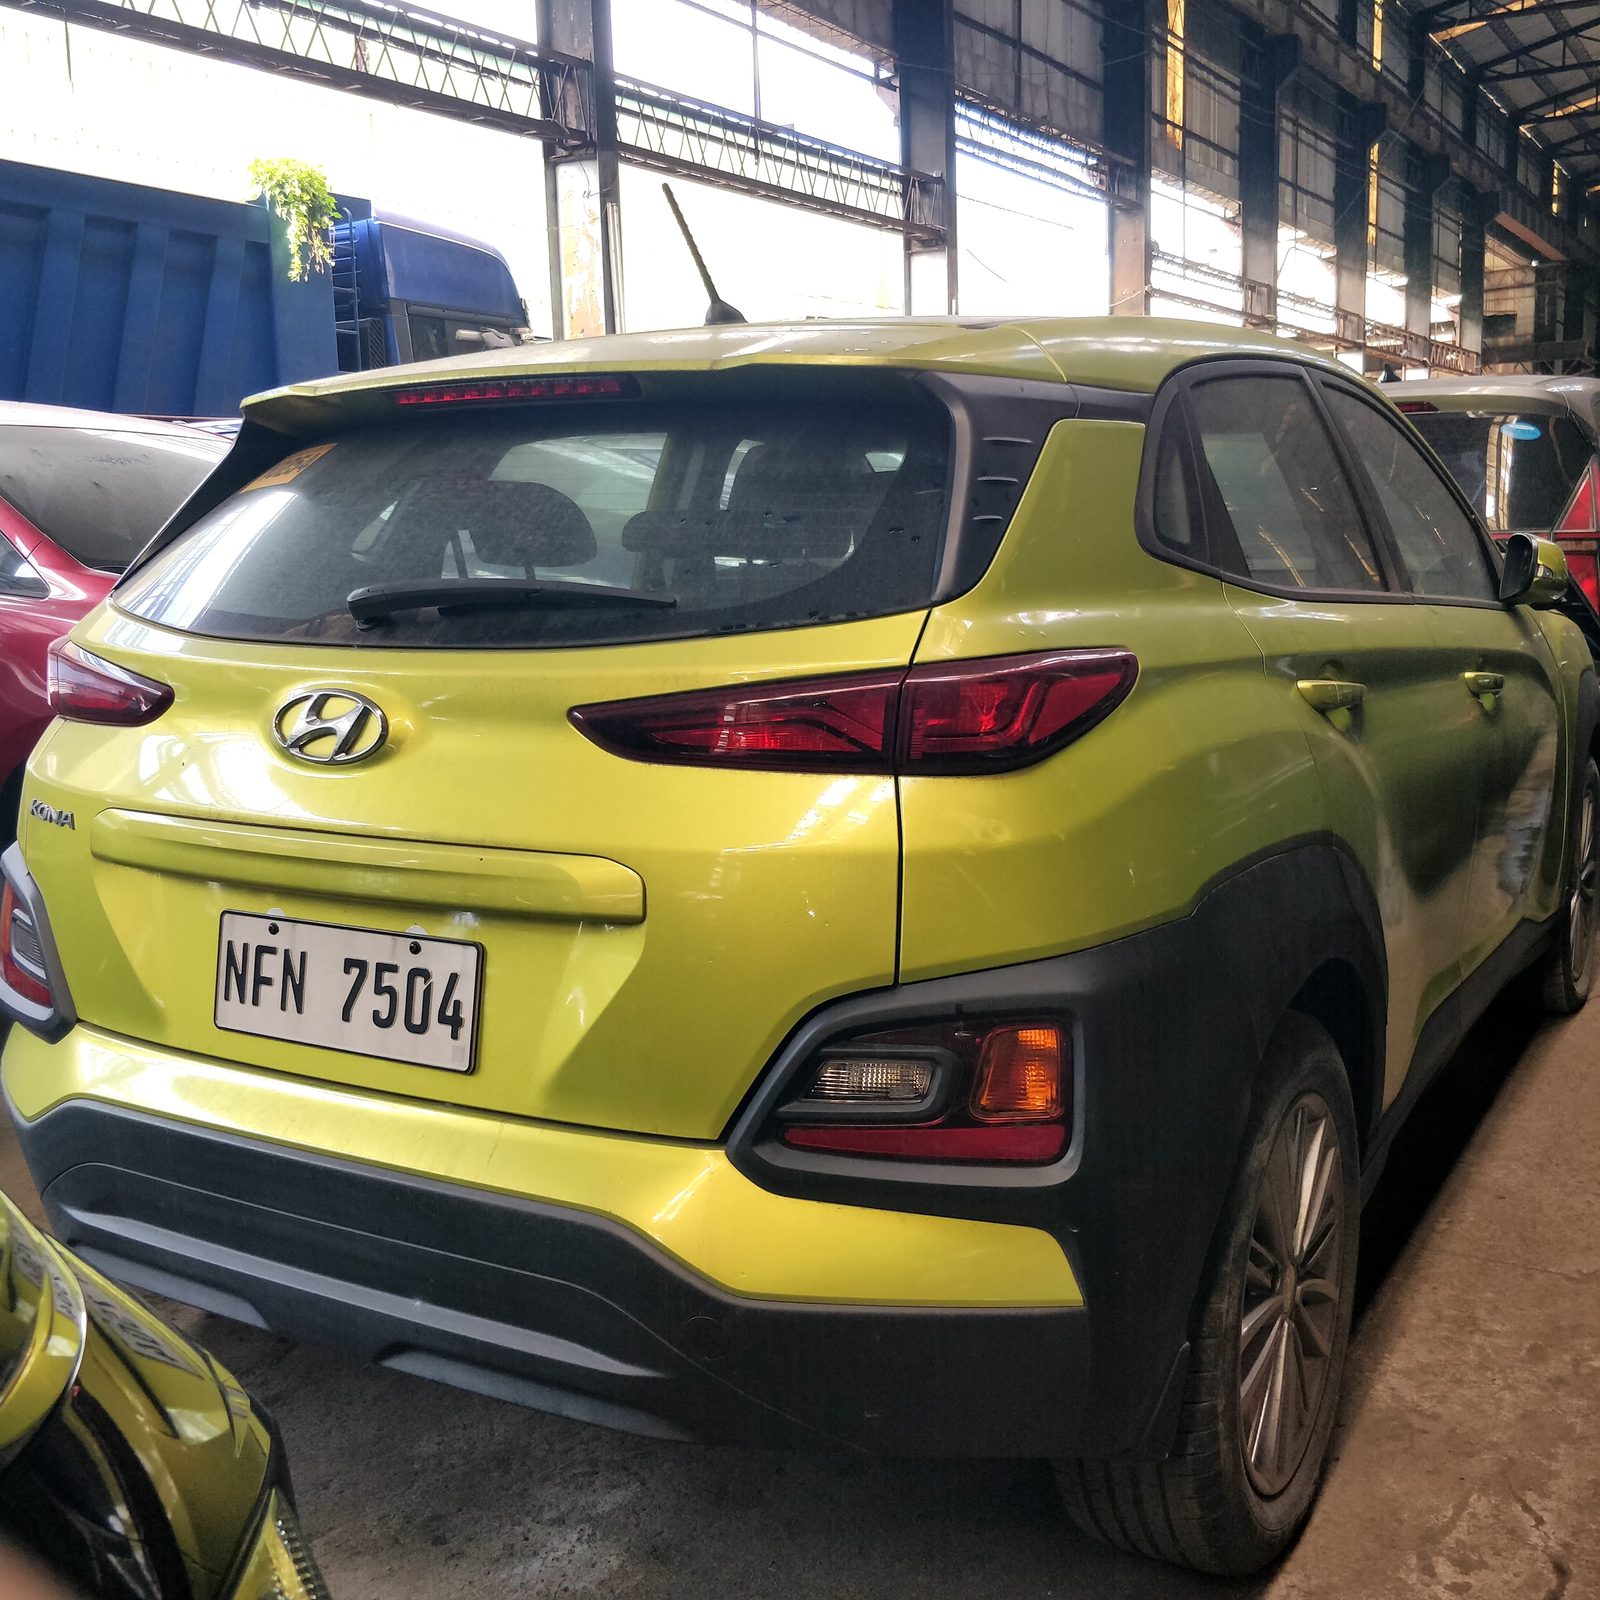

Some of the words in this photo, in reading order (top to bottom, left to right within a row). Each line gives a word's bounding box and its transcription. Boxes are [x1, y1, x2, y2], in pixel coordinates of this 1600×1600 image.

[31, 799, 76, 831] KONA
[224, 940, 307, 1014] NFN
[341, 958, 464, 1040] 7504
